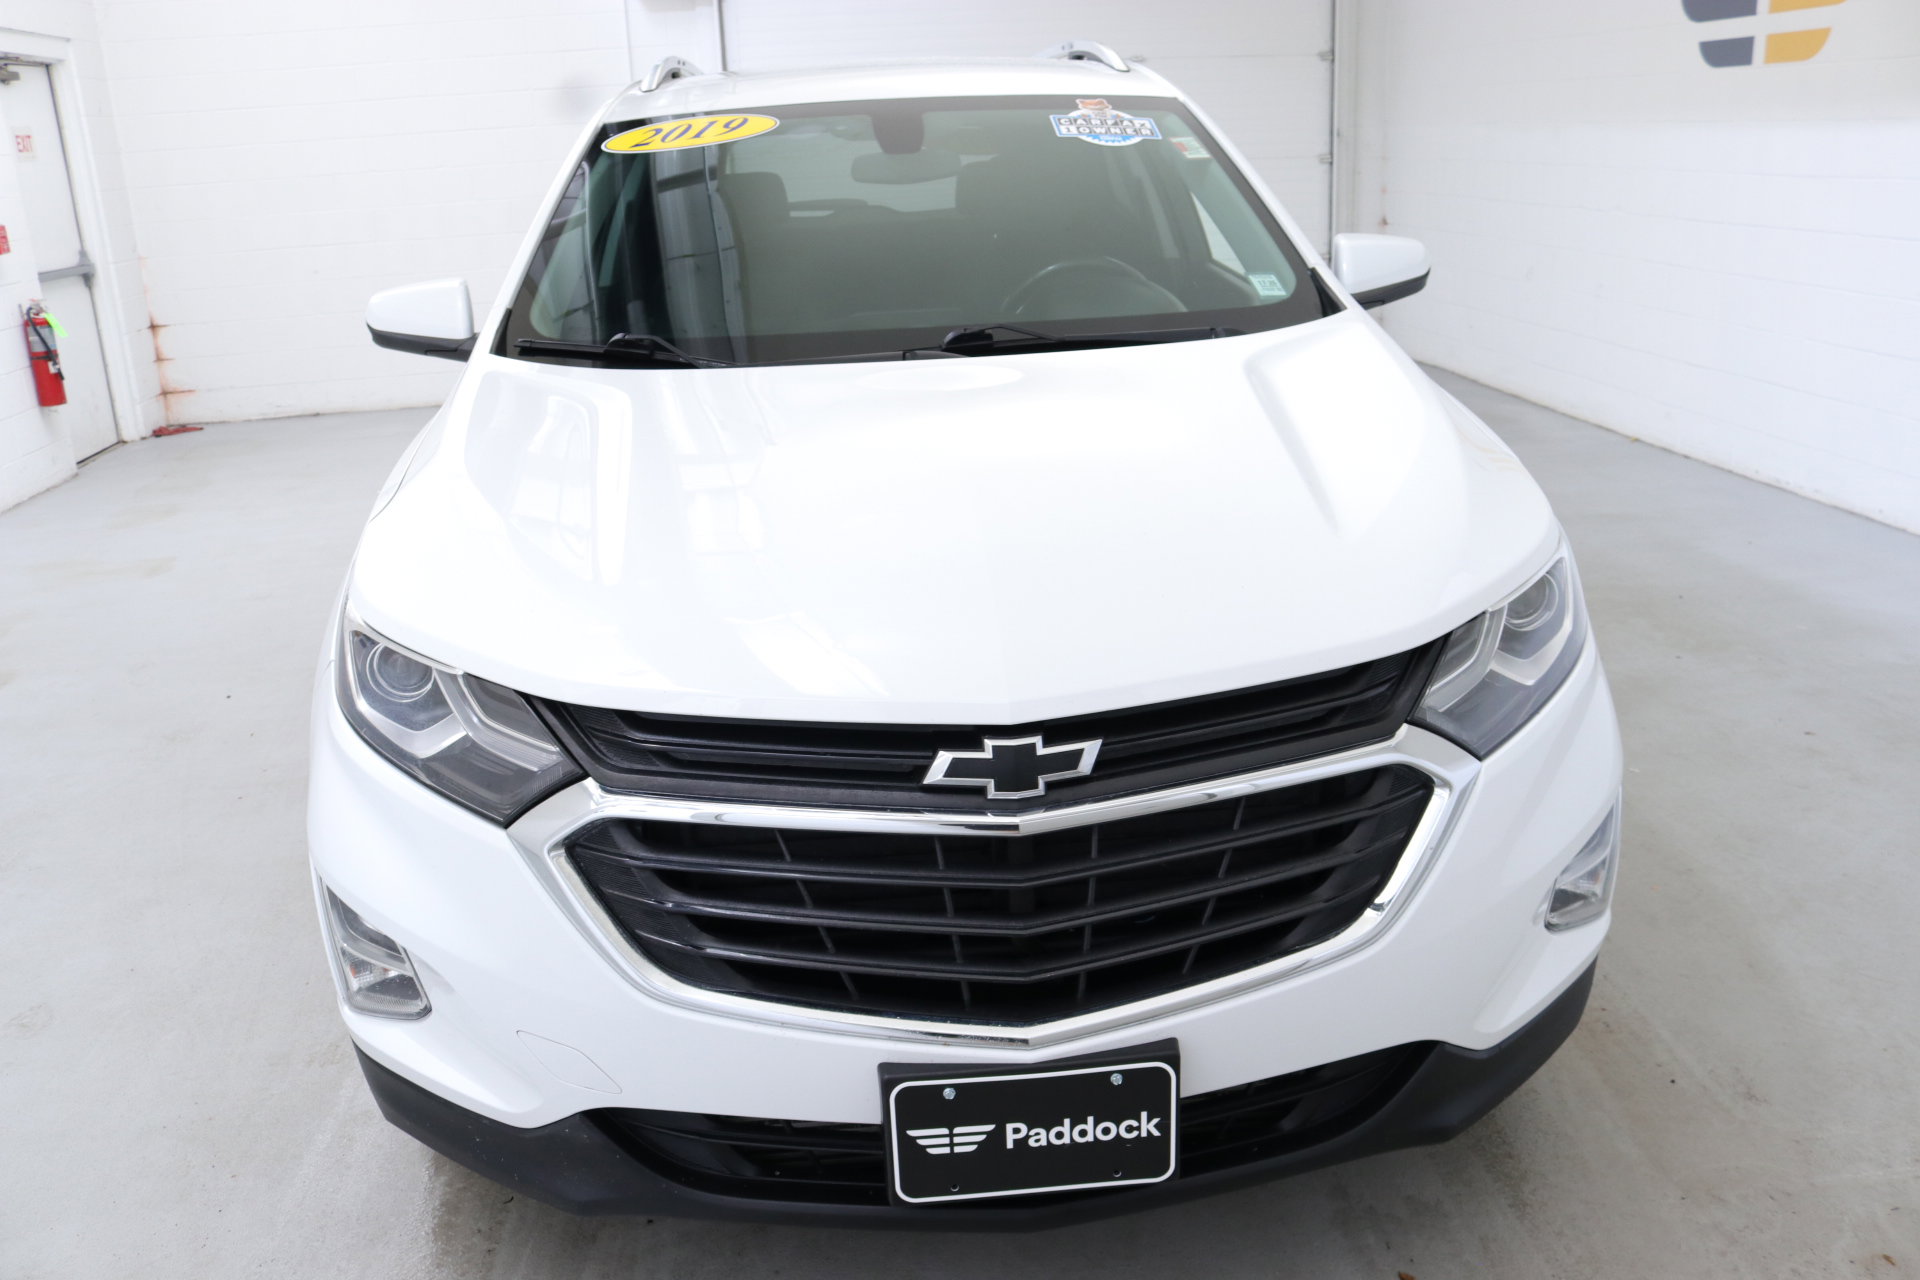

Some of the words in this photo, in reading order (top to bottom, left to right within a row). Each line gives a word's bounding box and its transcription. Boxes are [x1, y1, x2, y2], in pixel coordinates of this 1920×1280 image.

[1059, 118, 1152, 128] CARFAX
[1078, 126, 1153, 136] OWNER
[629, 117, 749, 149] 2019
[16, 135, 33, 152] EXIT
[1005, 1111, 1162, 1149] Paddock
